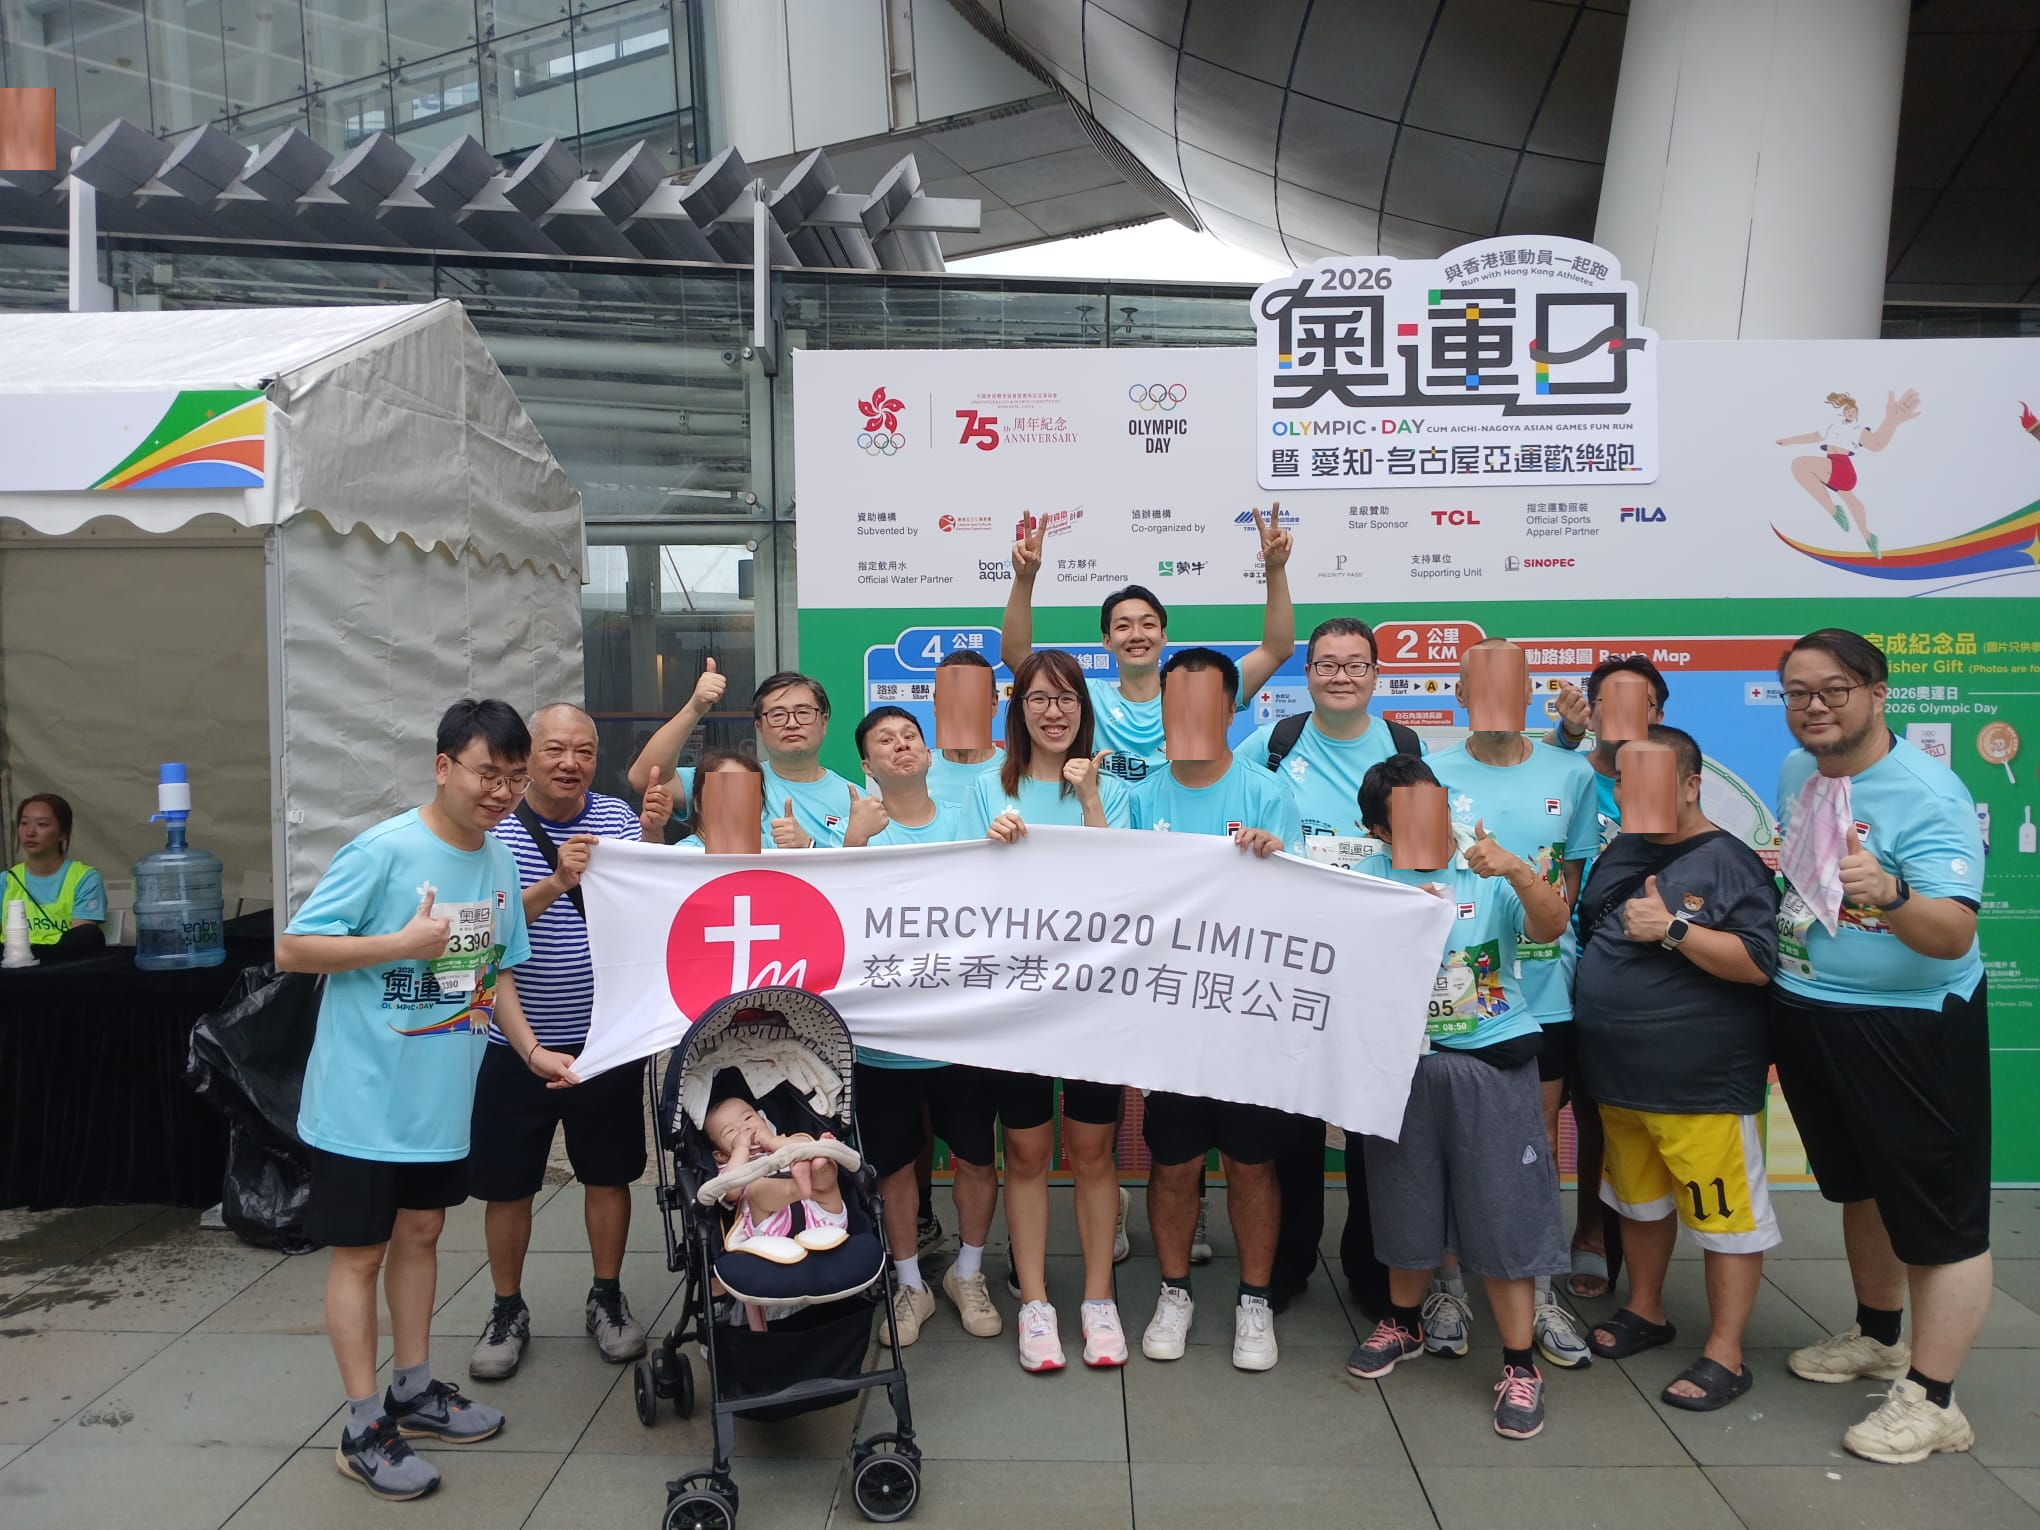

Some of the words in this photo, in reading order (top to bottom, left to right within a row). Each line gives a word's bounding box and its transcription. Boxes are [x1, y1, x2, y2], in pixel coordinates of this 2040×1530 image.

[1444, 248, 1609, 283] 與香港運動員一起跑
[1320, 268, 1392, 291] 2026
[1461, 276, 1480, 287] Run
[1481, 270, 1501, 281] with
[1504, 268, 1529, 276] Hong
[1531, 267, 1555, 277] Kong
[1556, 270, 1594, 287] Athletes
[1261, 279, 1647, 416] 奧運日
[956, 409, 1000, 451] 75
[1013, 416, 1068, 432] 周年紀念
[1128, 418, 1188, 436] OLYMPIC
[1272, 420, 1366, 436] OLYMPIC
[1381, 418, 1425, 435] DAY
[1427, 425, 1448, 433] CUM
[1450, 424, 1521, 433] AICHI-NAGOYA
[1523, 424, 1553, 432] ASIAN
[1556, 423, 1588, 431] GAMES
[1590, 423, 1610, 431] FUN
[1612, 422, 1634, 430] RUN
[1003, 433, 1079, 444] ANNIVERSARY
[1145, 437, 1171, 454] DAY
[1131, 508, 1172, 520] 協辦機構
[1526, 502, 1589, 513] 指定運動服裝
[857, 511, 897, 522] 資助機構
[1430, 509, 1481, 526] TCL
[1526, 516, 1559, 525] Official
[1560, 515, 1592, 526] Sports
[1619, 506, 1668, 523] FILA
[856, 526, 905, 536] Subvented
[907, 526, 919, 537] by
[1131, 523, 1192, 534] Co-organized
[1194, 522, 1206, 534] by
[1348, 520, 1368, 530] Star
[1370, 520, 1409, 530] Sponsor
[1525, 527, 1562, 538] Apparel
[1564, 527, 1600, 537] Partner
[857, 560, 908, 571] 指定飲用水
[978, 559, 1004, 571] bon
[1057, 559, 1097, 569] 官方夥伴
[1410, 554, 1452, 565] 支持單位
[1523, 558, 1576, 568] SINOPEC
[857, 575, 889, 584] Official
[890, 575, 918, 584] Water
[920, 575, 954, 584] Partner
[979, 570, 1012, 583] aqua
[1056, 573, 1088, 582] Official
[1090, 573, 1129, 582] Partners
[1410, 568, 1461, 579] Supporting
[1463, 567, 1482, 577] Unit
[951, 632, 984, 650] 公里
[1426, 627, 1461, 645] 公里
[920, 634, 945, 664] 4
[1395, 629, 1420, 660] 2
[1427, 645, 1459, 660] KM
[1652, 649, 1691, 667] Map
[1887, 659, 1929, 674] isher
[1932, 659, 1965, 674] Gift
[1968, 663, 2009, 674] (Photos
[1425, 680, 1438, 692] A
[1549, 680, 1559, 690] E
[912, 693, 929, 701] Start
[1390, 688, 1408, 696] Start
[1886, 686, 1959, 701] 2026奧運日
[1884, 703, 1916, 714] 2026
[1919, 702, 1971, 715] Olympic
[1974, 703, 1998, 715] Day
[864, 906, 1156, 947] MERCYHK2020
[1170, 917, 1337, 976] LIMITED
[859, 952, 1331, 1031] 慈悲香港2020有限公司
[1428, 999, 1455, 1018] 95
[1442, 1022, 1467, 1032] 08:50
[1684, 1177, 1735, 1222] 11
